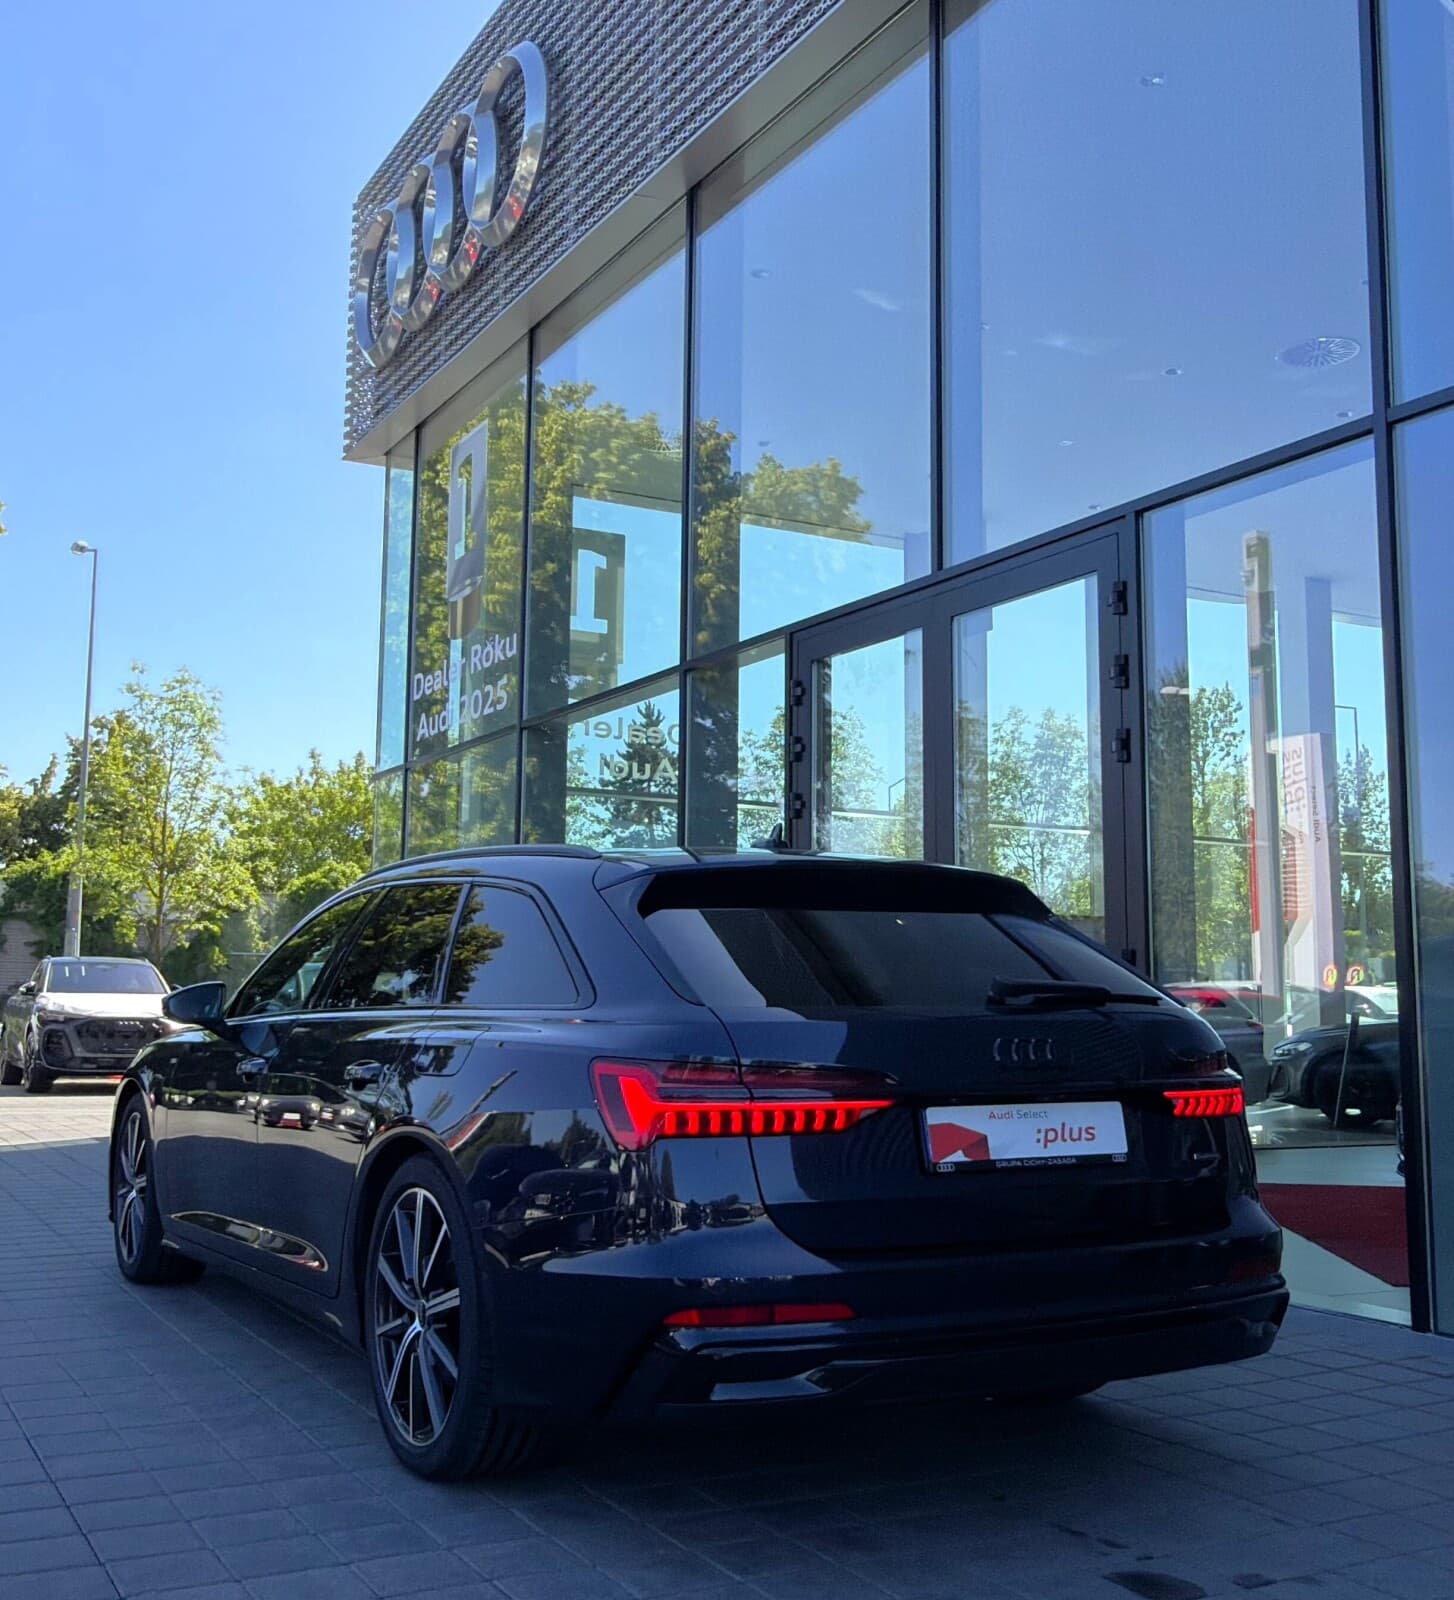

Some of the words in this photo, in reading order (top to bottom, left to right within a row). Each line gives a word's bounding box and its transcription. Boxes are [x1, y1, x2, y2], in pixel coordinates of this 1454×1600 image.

[413, 657, 466, 701] Dealer
[470, 633, 517, 674] Roku
[459, 676, 508, 725] 2025
[988, 1110, 1014, 1121] Audi
[1016, 1109, 1048, 1119] Select
[1035, 1121, 1097, 1149] :plus
